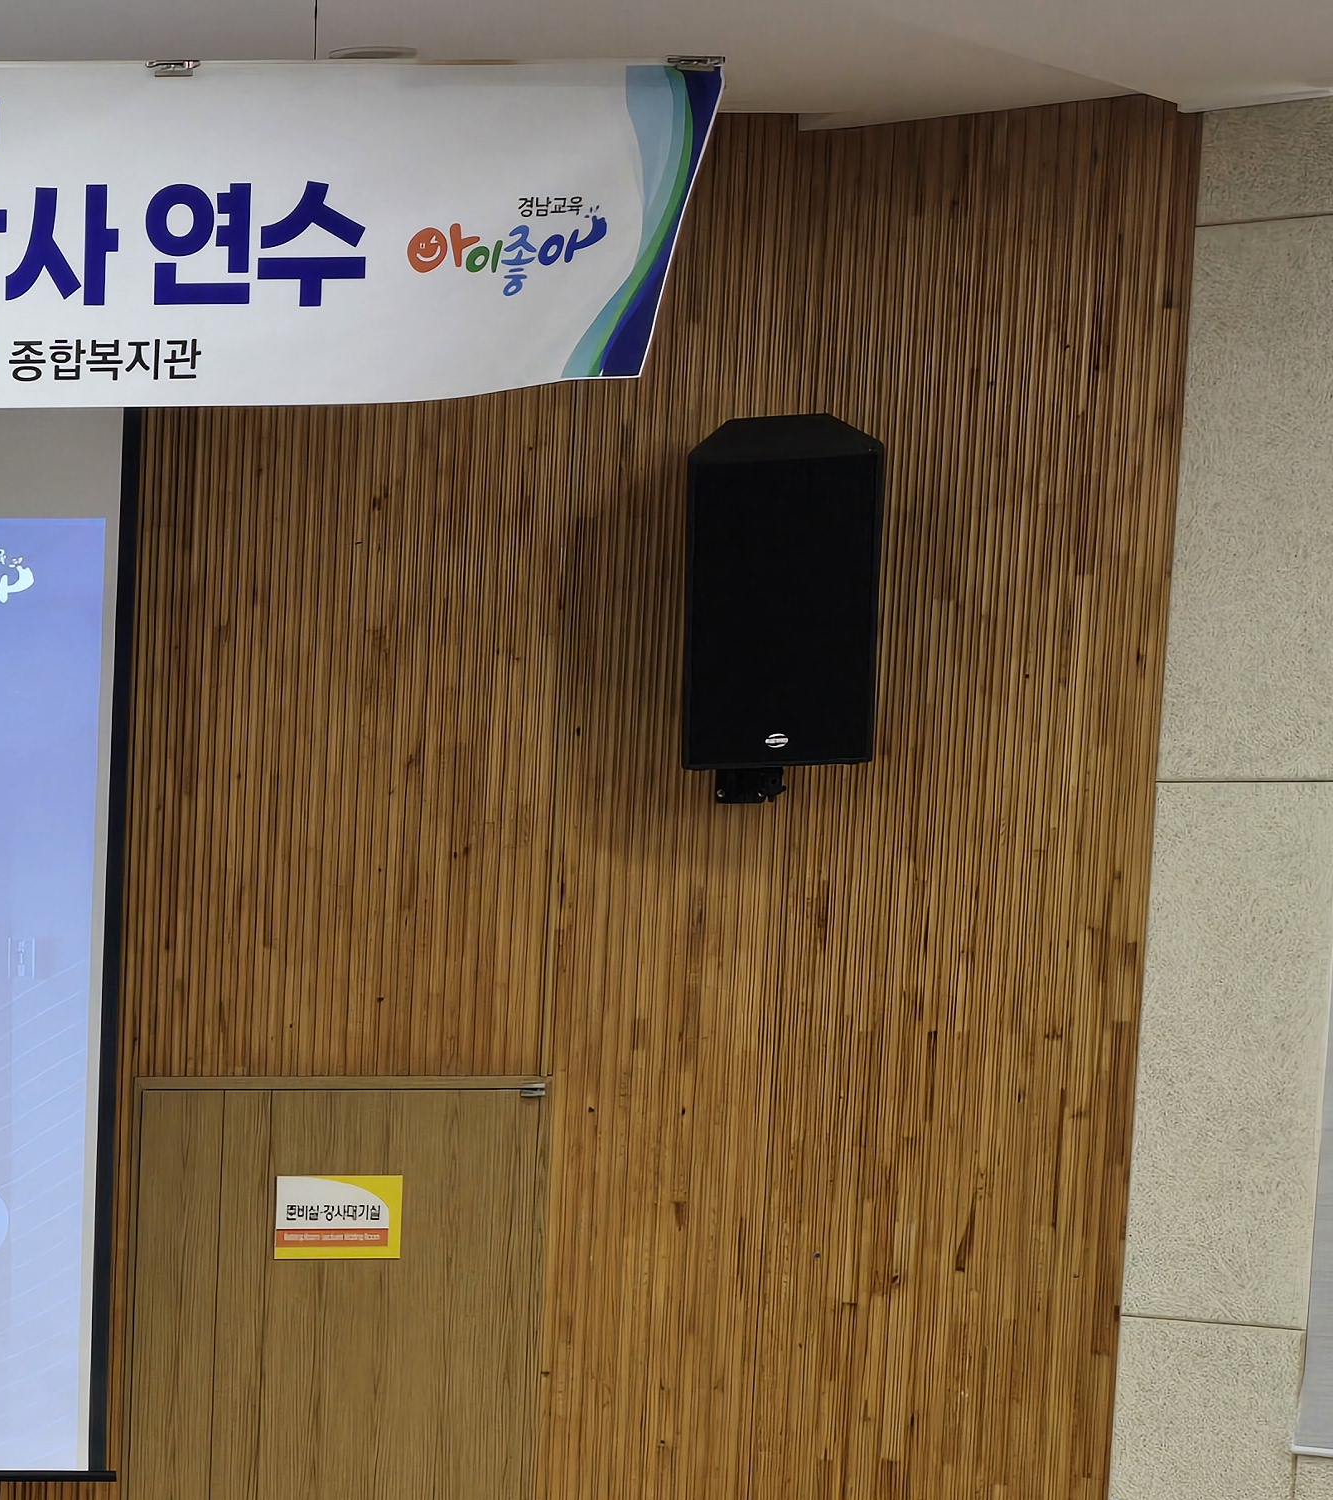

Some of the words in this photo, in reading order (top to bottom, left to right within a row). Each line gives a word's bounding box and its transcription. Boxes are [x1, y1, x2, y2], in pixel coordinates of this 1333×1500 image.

[515, 194, 584, 219] 경남교육
[145, 180, 367, 308] 연수
[406, 222, 608, 297] 아이좋아
[8, 338, 202, 382] 종합복지관
